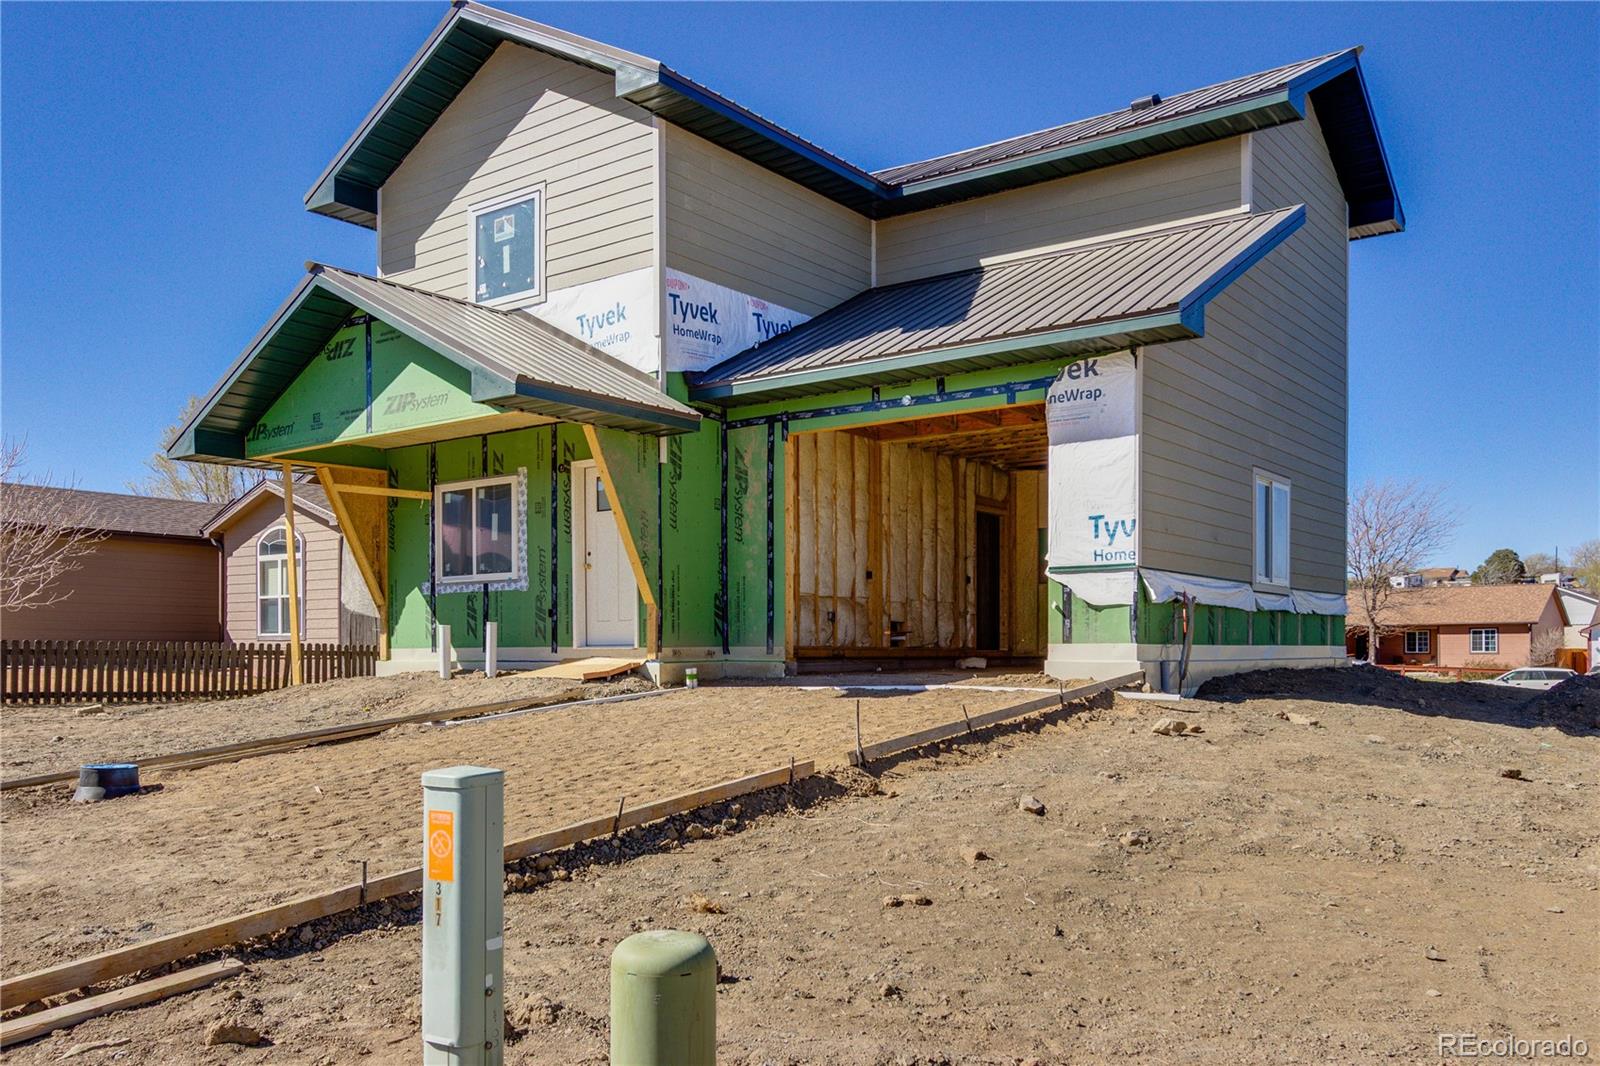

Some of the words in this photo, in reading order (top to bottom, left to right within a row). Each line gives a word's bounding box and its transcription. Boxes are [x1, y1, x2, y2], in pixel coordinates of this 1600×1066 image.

[576, 301, 627, 339] Tyvek
[668, 292, 719, 326] Tyvek
[672, 323, 723, 346] HomeWrap
[1093, 549, 1136, 562] Home
